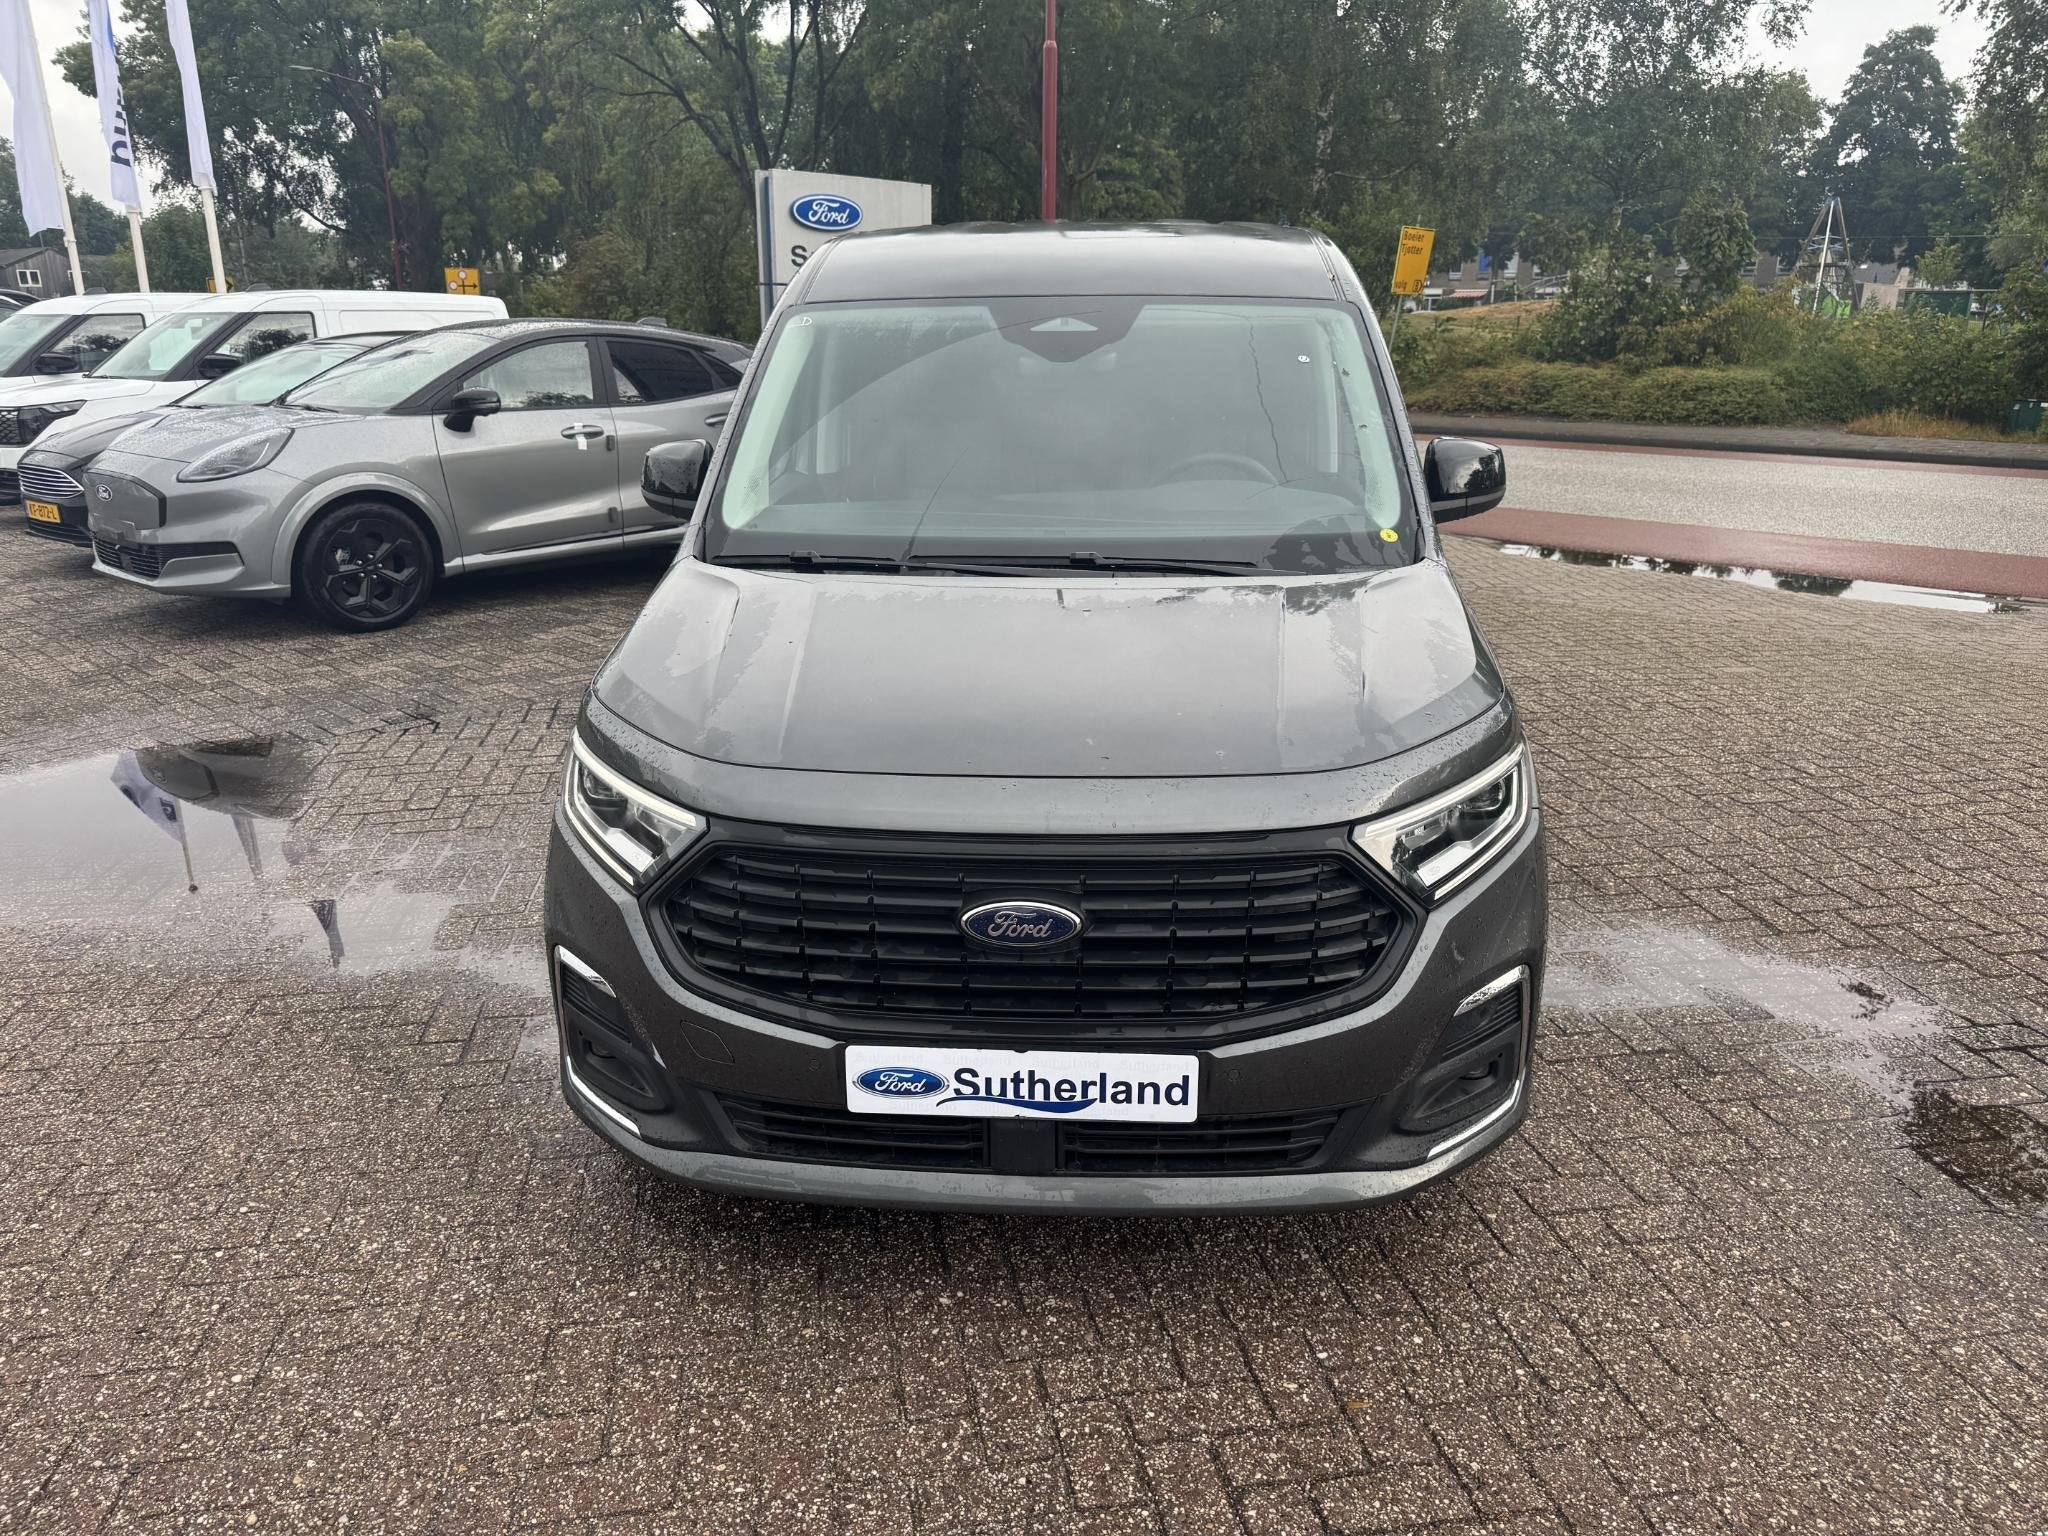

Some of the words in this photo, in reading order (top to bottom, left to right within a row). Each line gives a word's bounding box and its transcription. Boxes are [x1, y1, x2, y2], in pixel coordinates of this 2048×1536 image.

[808, 200, 850, 224] Ford
[987, 911, 1053, 939] Ford
[874, 1071, 926, 1093] Ford
[953, 1067, 1190, 1106] Sutherland
